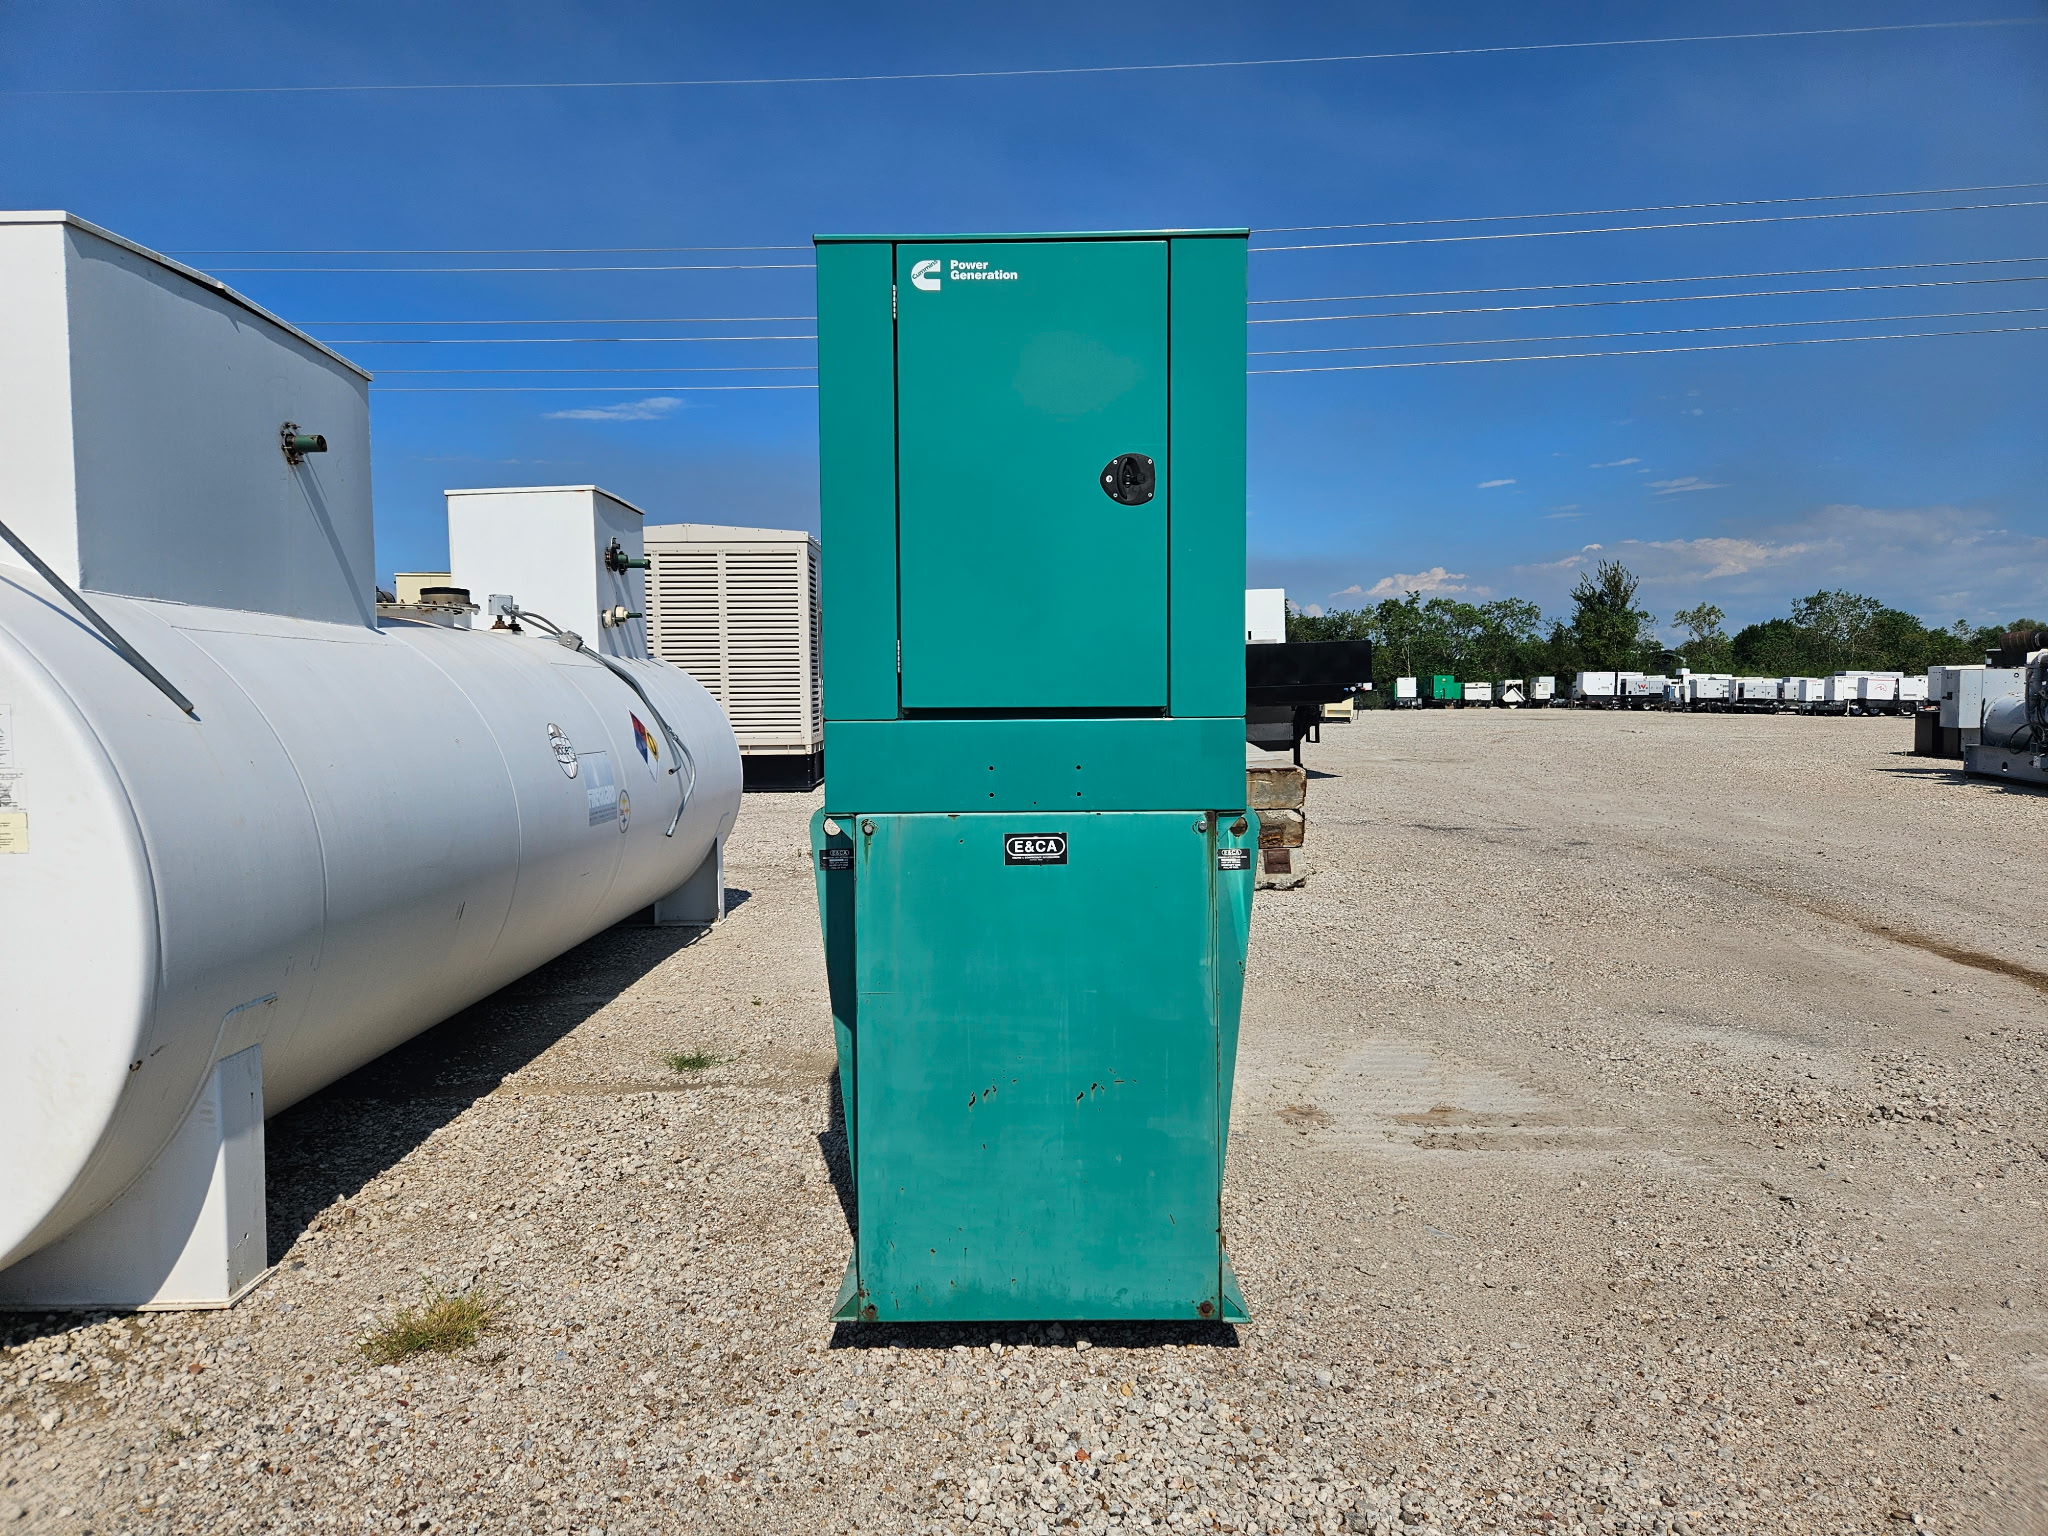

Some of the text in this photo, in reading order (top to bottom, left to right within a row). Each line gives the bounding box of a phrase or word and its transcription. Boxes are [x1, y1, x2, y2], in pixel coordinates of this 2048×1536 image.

[912, 260, 938, 279] Cummins
[950, 260, 988, 270] Power
[950, 270, 1018, 280] Generation
[1014, 840, 1057, 853] E&CA
